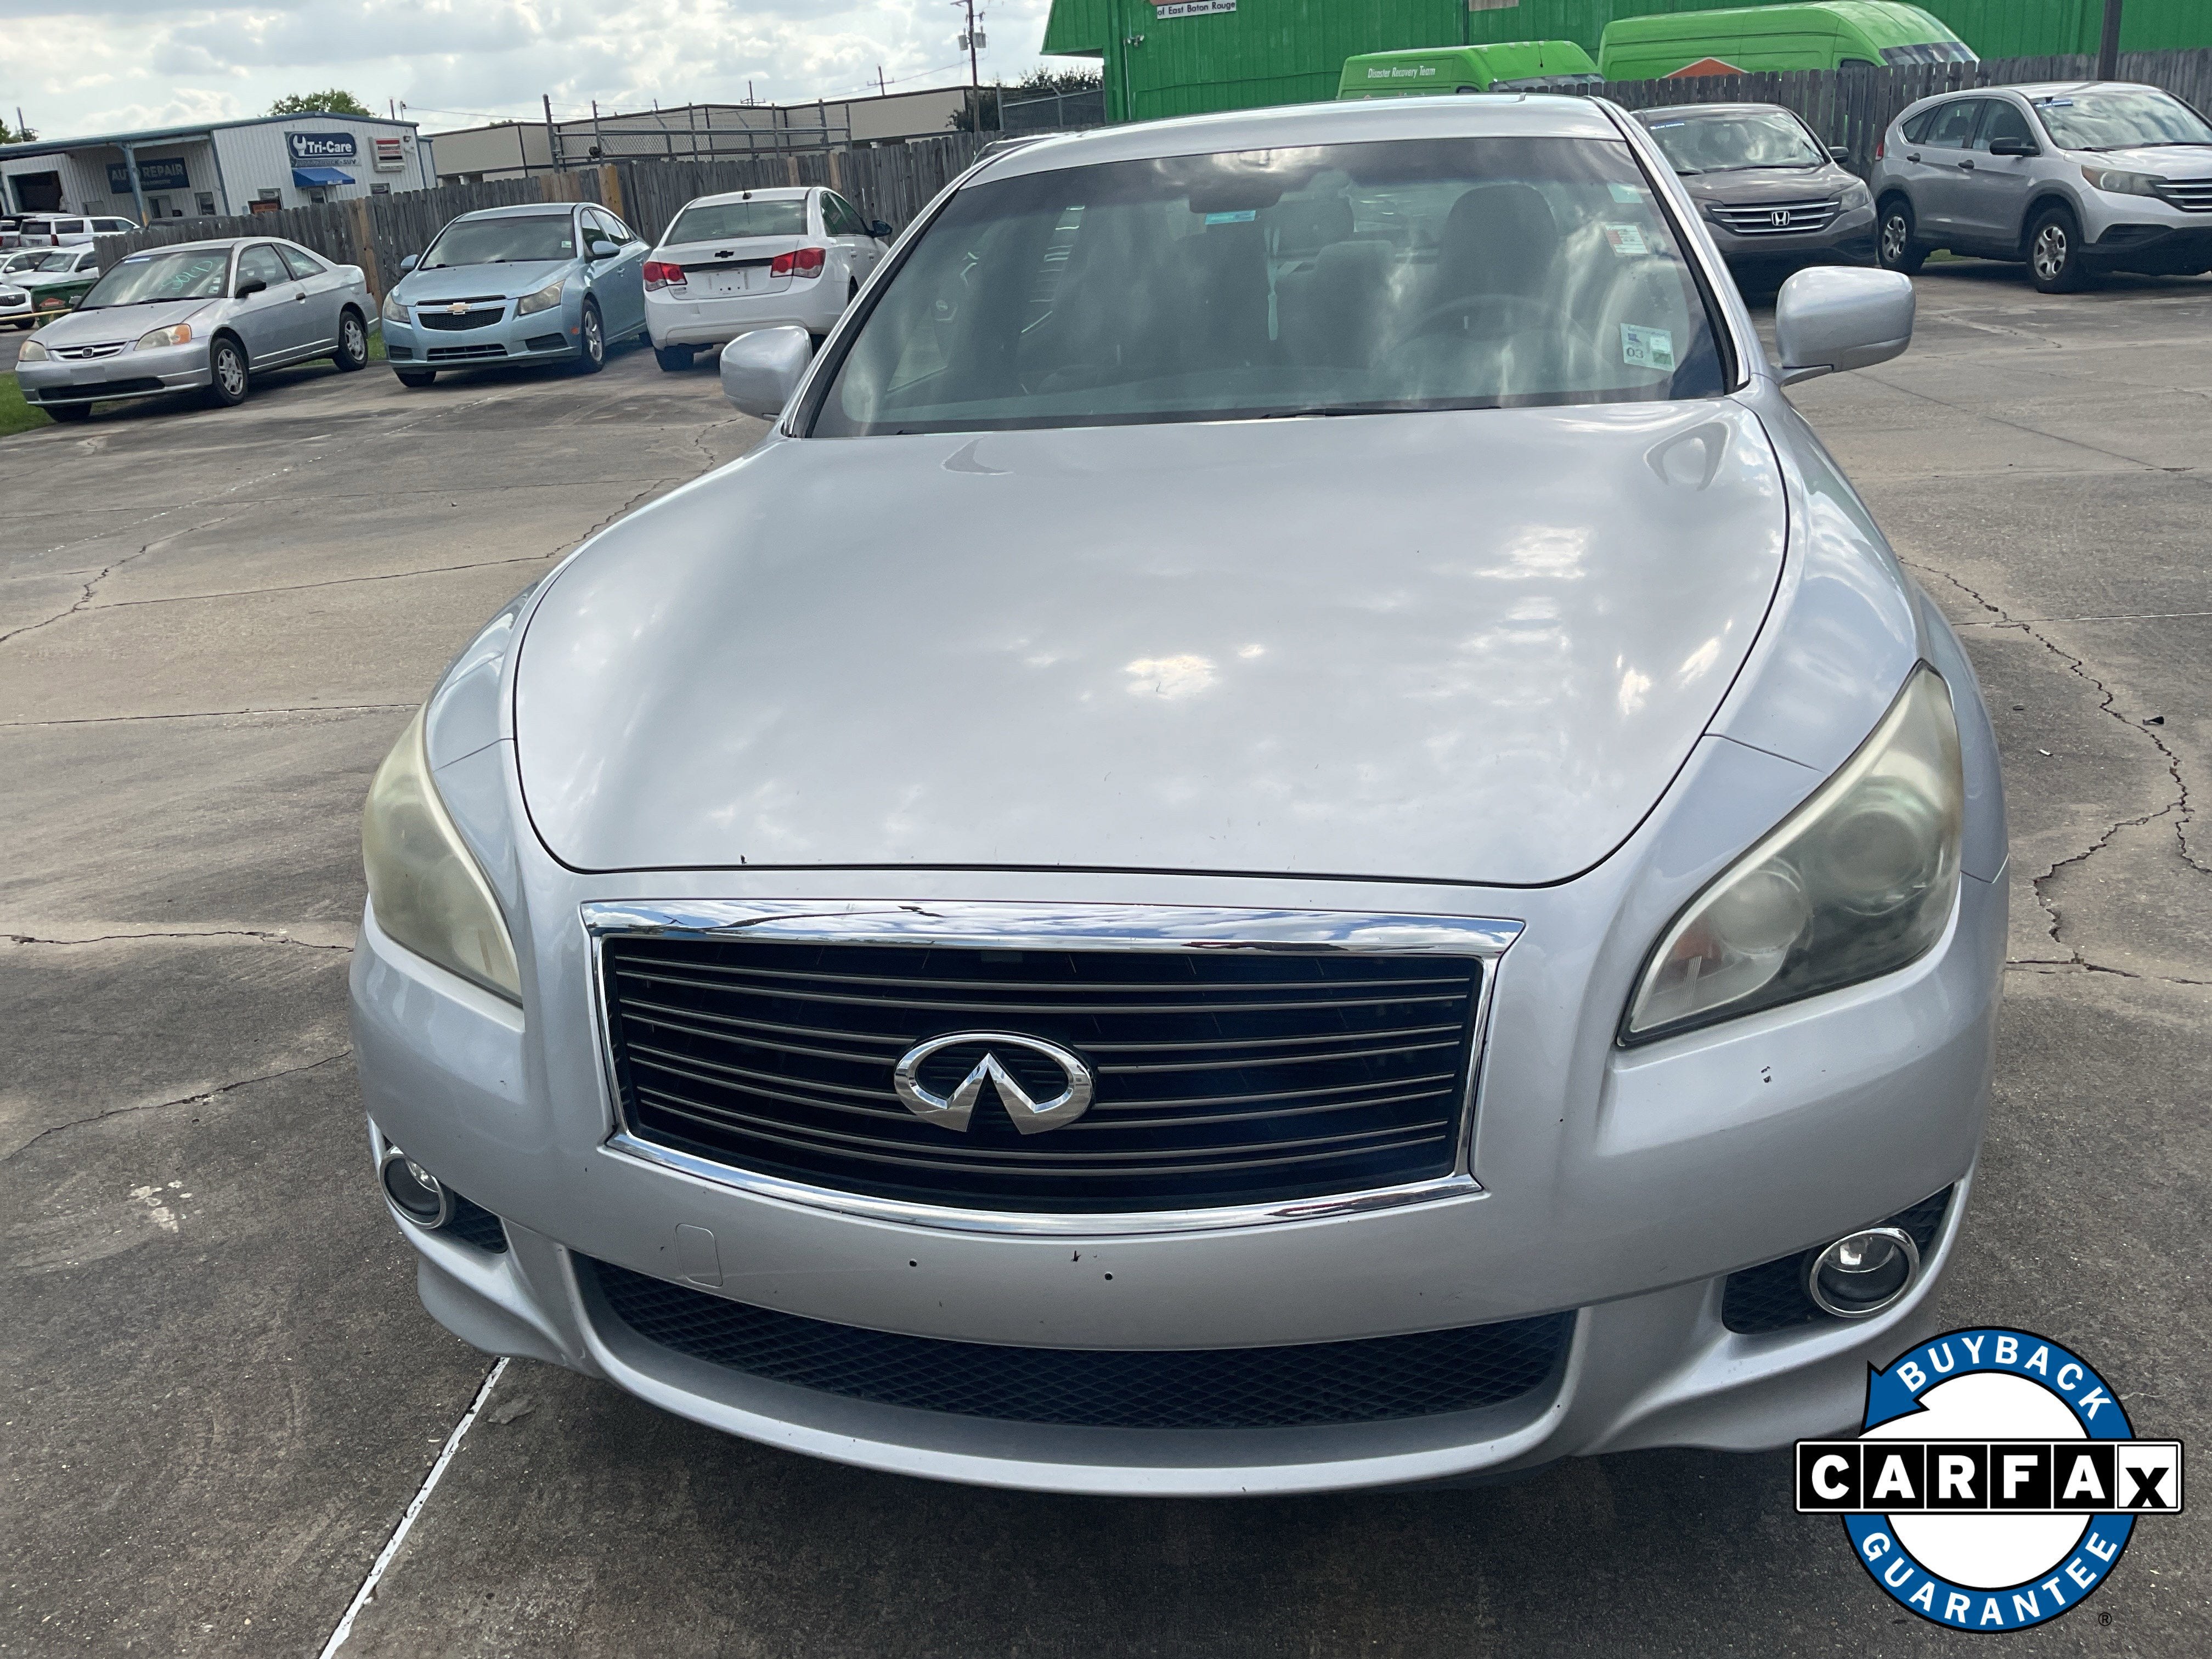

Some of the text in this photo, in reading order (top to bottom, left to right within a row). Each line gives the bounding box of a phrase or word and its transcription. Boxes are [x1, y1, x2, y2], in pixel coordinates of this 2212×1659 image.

[1157, 2, 1236, 16] of East Baton Rouge
[1368, 65, 1436, 79] Disaster Recovery Team
[308, 140, 352, 154] Tri-Care
[142, 163, 184, 178] REPAIR
[1626, 347, 1644, 359] 03
